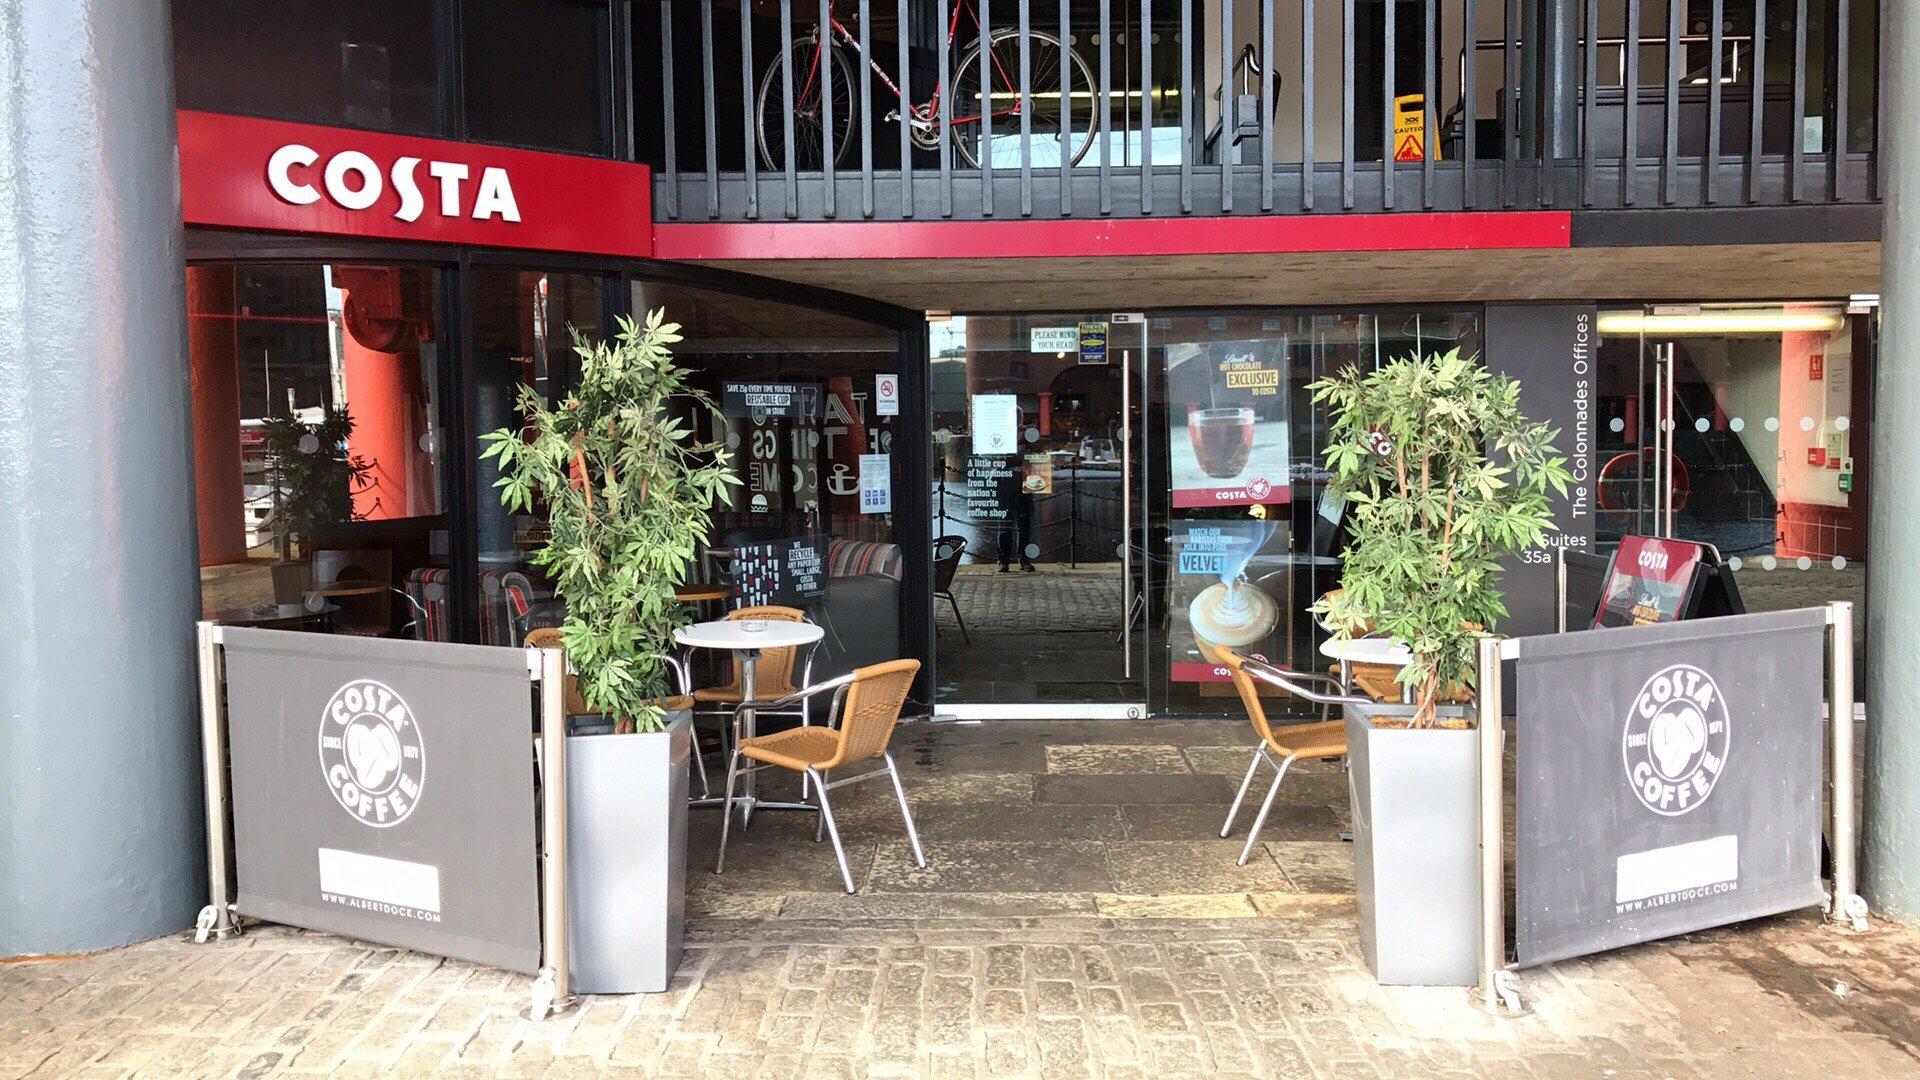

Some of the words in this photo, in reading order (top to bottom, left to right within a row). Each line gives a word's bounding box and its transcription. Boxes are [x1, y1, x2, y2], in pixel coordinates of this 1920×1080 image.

[1394, 126, 1423, 134] CAUTIO
[268, 144, 522, 222] COSTA
[1034, 331, 1058, 339] PLEASE
[1059, 331, 1076, 339] MIND
[1037, 341, 1054, 349] YOUR
[1055, 341, 1073, 349] HEAD
[1573, 313, 1587, 374] Offices
[1220, 363, 1231, 371] HOT
[1231, 361, 1262, 371] CHOCOLATE
[1229, 372, 1276, 386] EXCLUSIVE
[727, 384, 739, 393] SAVE
[739, 384, 748, 394] 25p
[748, 384, 762, 393] EVERY
[763, 384, 774, 393] TIME
[774, 384, 783, 393] YOU
[784, 384, 793, 393] USE
[793, 384, 797, 393] A
[1252, 388, 1259, 396] TO
[1260, 387, 1277, 396] COSTA
[746, 394, 777, 405] REUSABLE
[777, 394, 789, 404] CUP
[772, 407, 786, 415] STORE
[1573, 381, 1587, 481] Colonnades
[967, 459, 973, 467] A
[975, 459, 991, 467] little
[993, 461, 1006, 470] cup
[967, 469, 975, 477] of
[976, 469, 1012, 479] happiness
[967, 479, 984, 487] from
[986, 479, 998, 487] the
[967, 489, 996, 497] nation's
[1215, 490, 1247, 500] COSTA
[967, 499, 999, 507] favourite
[1573, 487, 1587, 518] The
[967, 509, 988, 517] coffee
[1188, 528, 1208, 536] WATCH
[1208, 528, 1220, 536] OUR
[1541, 533, 1587, 546] Suites
[1183, 543, 1198, 551] MILK
[790, 548, 814, 560] RECYCLE
[1523, 550, 1551, 563] 35a
[1182, 555, 1225, 571] VELVET
[1638, 550, 1668, 570] COSTA
[1213, 667, 1232, 676] COS
[1639, 670, 1714, 719] COSTA
[331, 685, 406, 732] COSTA
[323, 735, 342, 750] SINCE
[1628, 733, 1647, 748] SINCE
[1633, 751, 1721, 810] COFFEE
[330, 764, 418, 822] COFFEE
[1616, 880, 1738, 915] WWW.ALBERTDOCK.COM
[321, 892, 441, 923] WWW.ALBERTDOCK.COM
